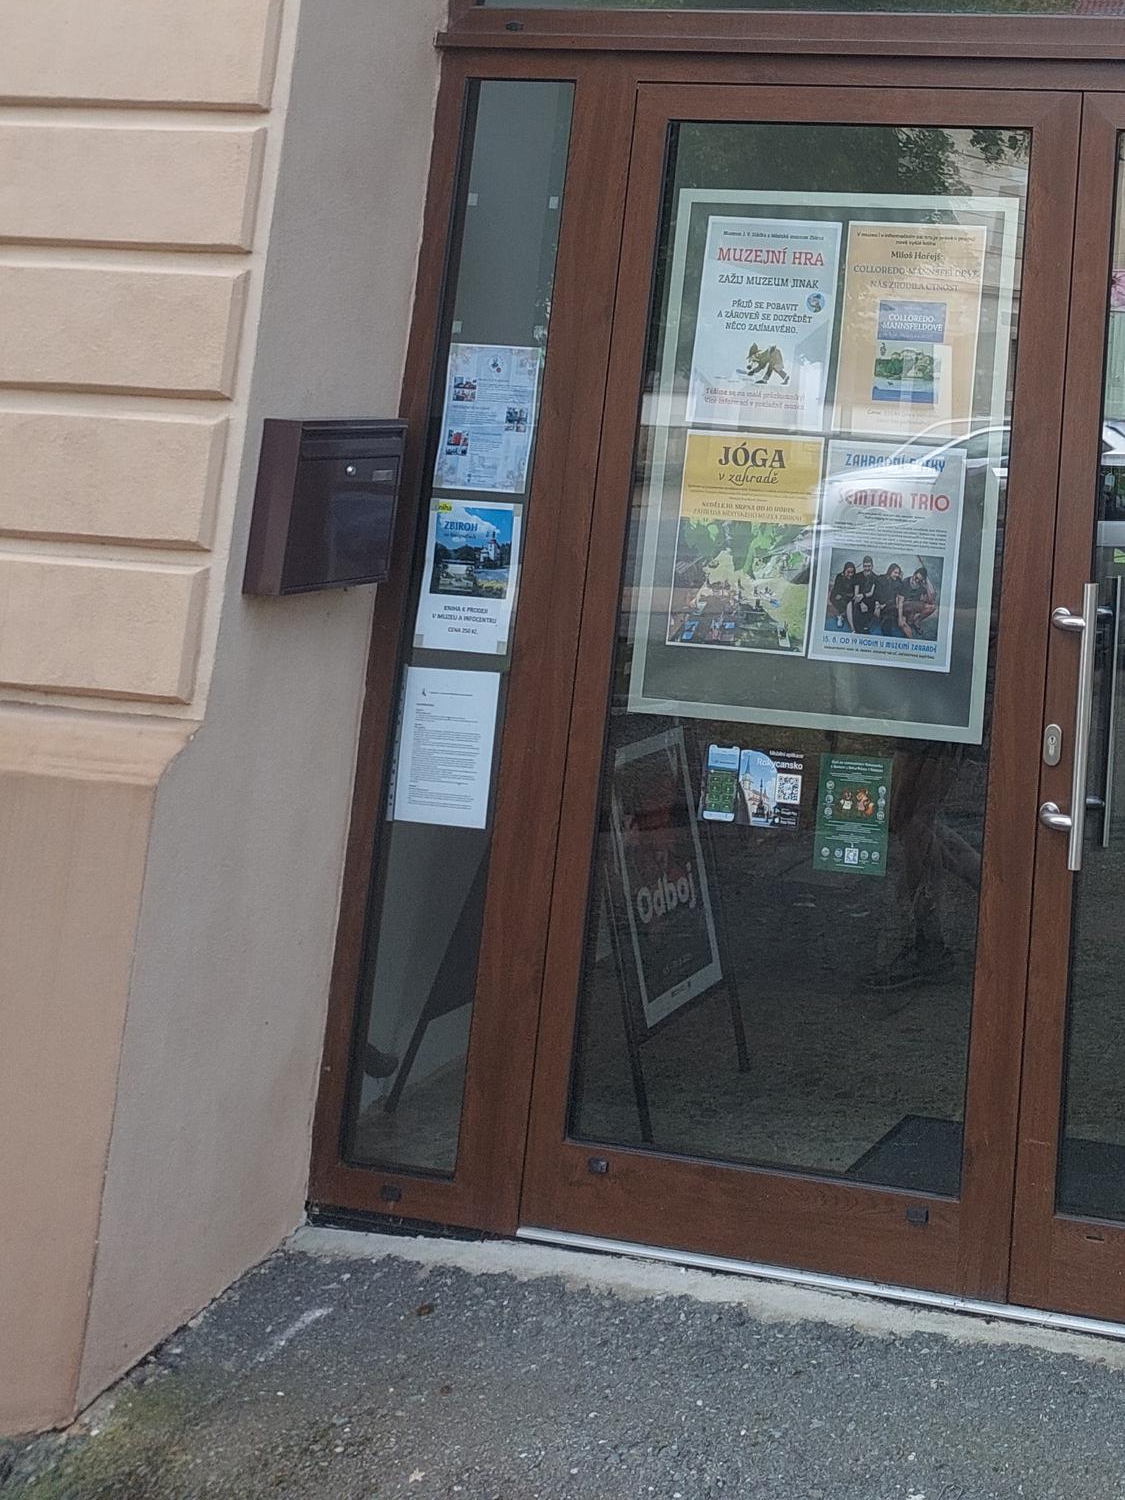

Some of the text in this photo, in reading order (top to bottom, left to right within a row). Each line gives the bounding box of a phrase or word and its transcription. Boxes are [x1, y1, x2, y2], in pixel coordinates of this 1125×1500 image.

[717, 247, 825, 267] MUZEJNÍ HRA
[718, 273, 819, 289] ZAŽIJ MUZEUM JINAK
[754, 301, 765, 309] SE
[766, 302, 799, 312] POBAVIT
[717, 310, 813, 324] A ZÁROVEŇ SE DOZVĚDĚT
[725, 321, 747, 331] NĚCO
[718, 442, 786, 469] JÓGA
[718, 465, 779, 486] v zahradě
[911, 493, 950, 512] TRIO
[443, 521, 479, 532] ZBIROH
[756, 757, 804, 770] Rokycansko
[636, 861, 697, 924] Odboj
